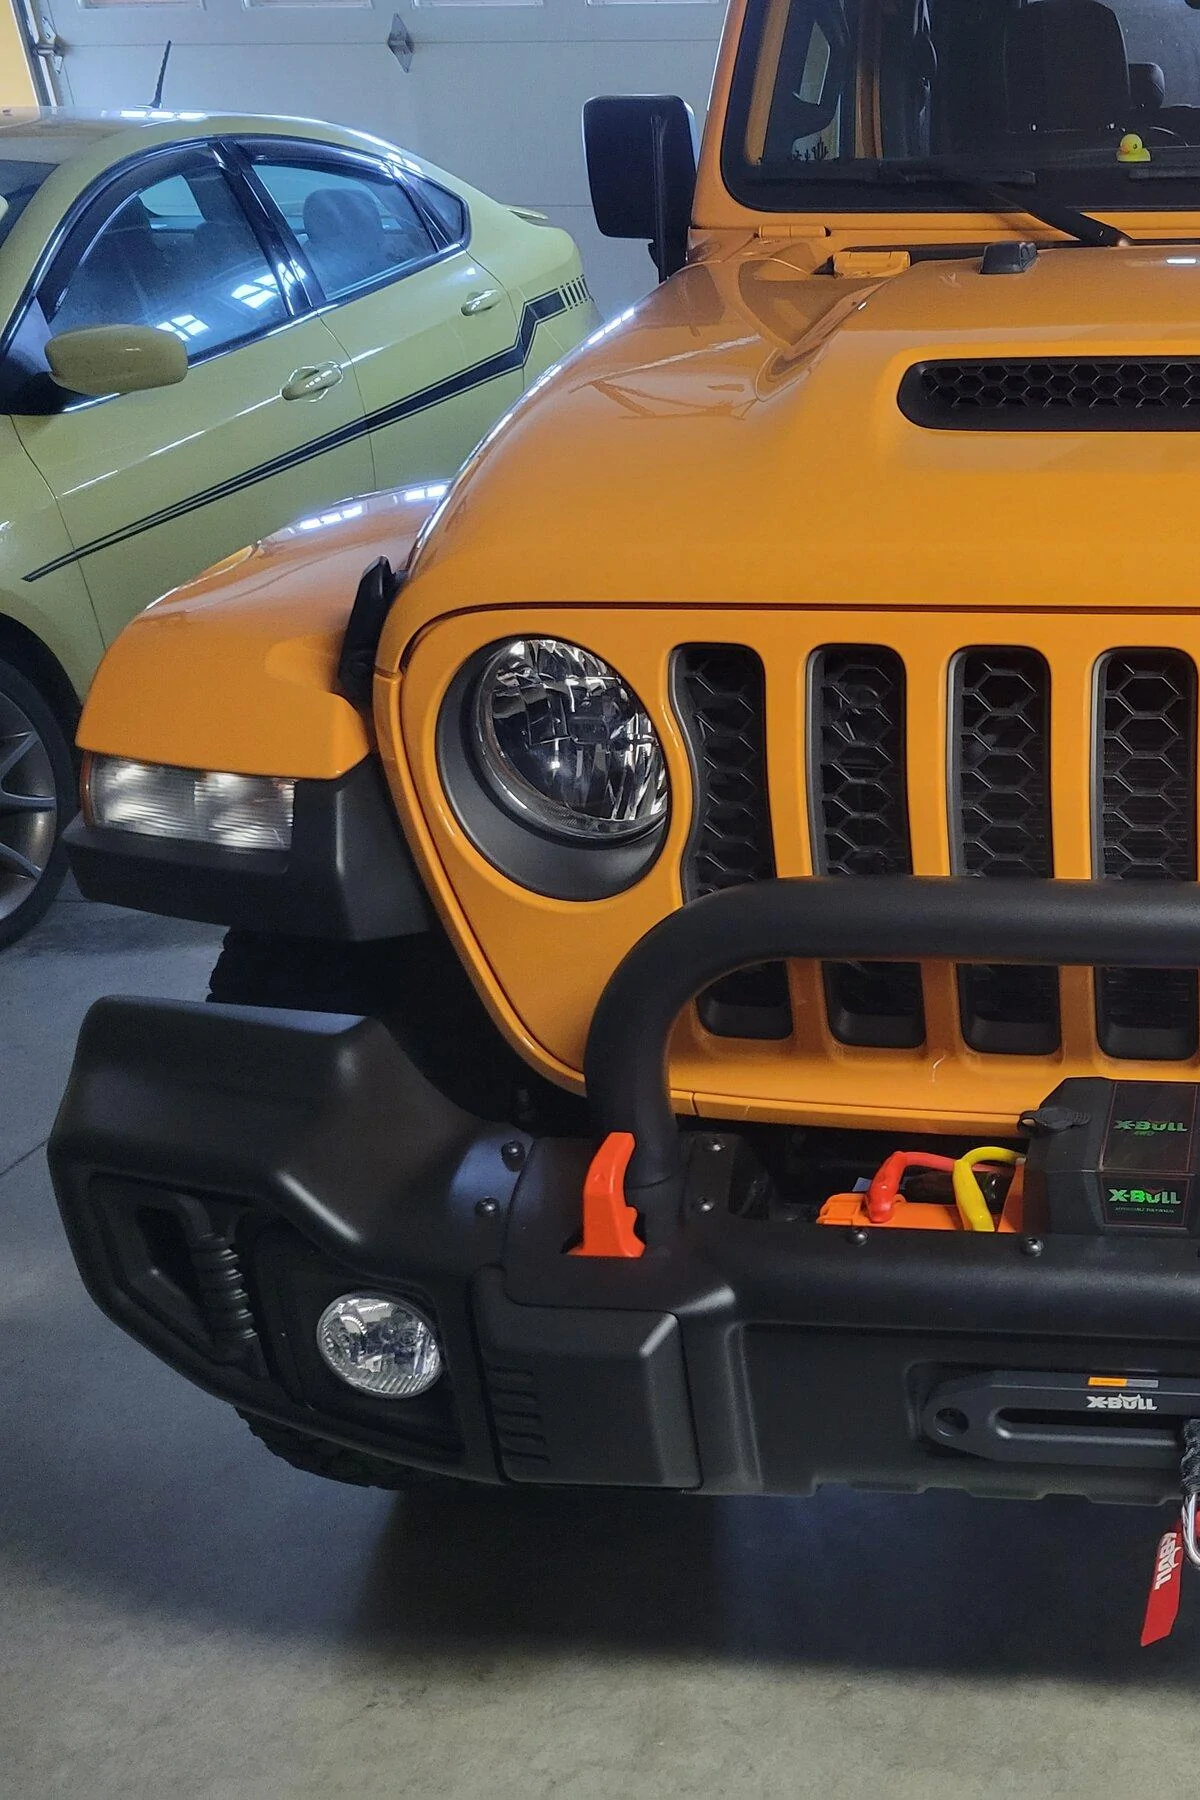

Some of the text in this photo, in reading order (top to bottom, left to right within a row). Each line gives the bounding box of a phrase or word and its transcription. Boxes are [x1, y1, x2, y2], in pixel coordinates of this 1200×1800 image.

[1113, 1120, 1188, 1132] X-BULL
[1108, 1188, 1182, 1205] X-BULL
[1086, 1394, 1158, 1411] X-BULL
